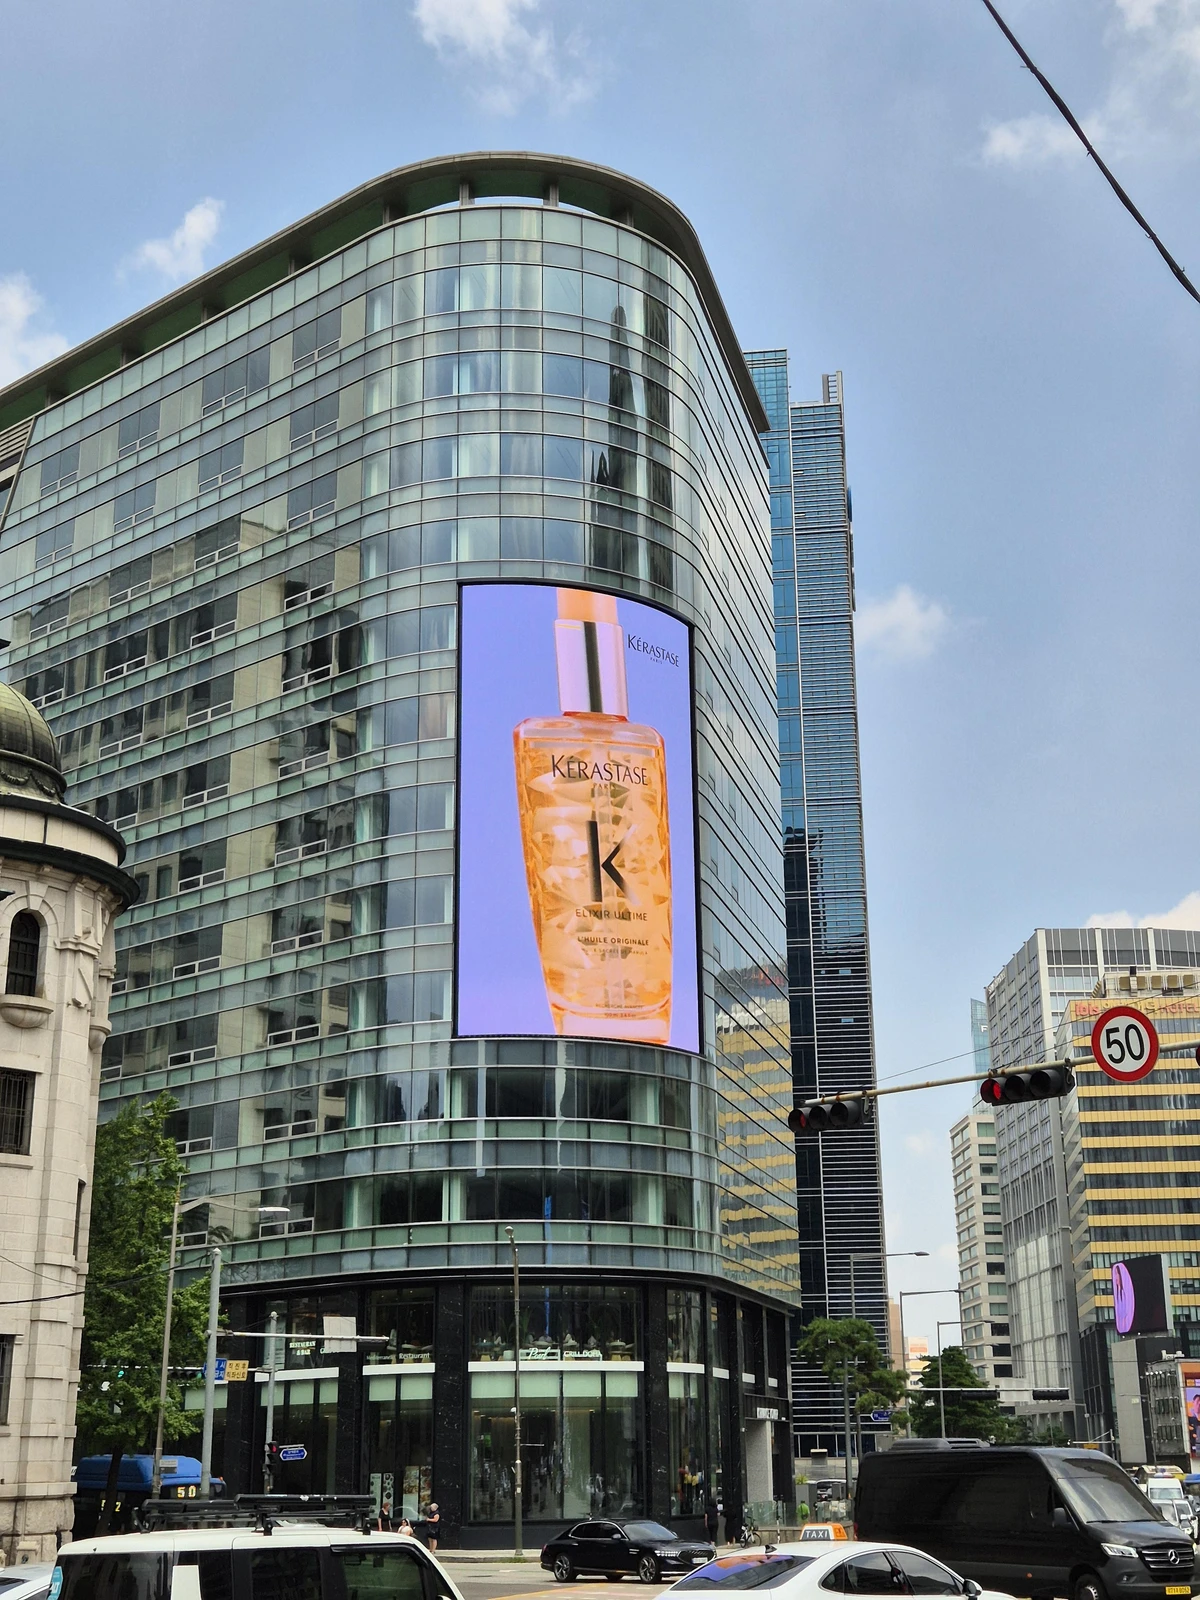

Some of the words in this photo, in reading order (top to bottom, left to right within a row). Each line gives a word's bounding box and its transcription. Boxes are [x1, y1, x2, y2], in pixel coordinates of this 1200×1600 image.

[628, 634, 679, 667] KÉRASTASE
[551, 755, 648, 785] KÉRASTASE
[575, 908, 610, 919] ELIXIR
[614, 910, 648, 921] ULTIME
[577, 936, 608, 944] L'HUILE
[610, 937, 649, 946] ORIGINALE
[1075, 1002, 1099, 1016] ibis
[1105, 1024, 1145, 1064] 50
[399, 1352, 430, 1360] Restaurant
[805, 1530, 828, 1538] TAXI
